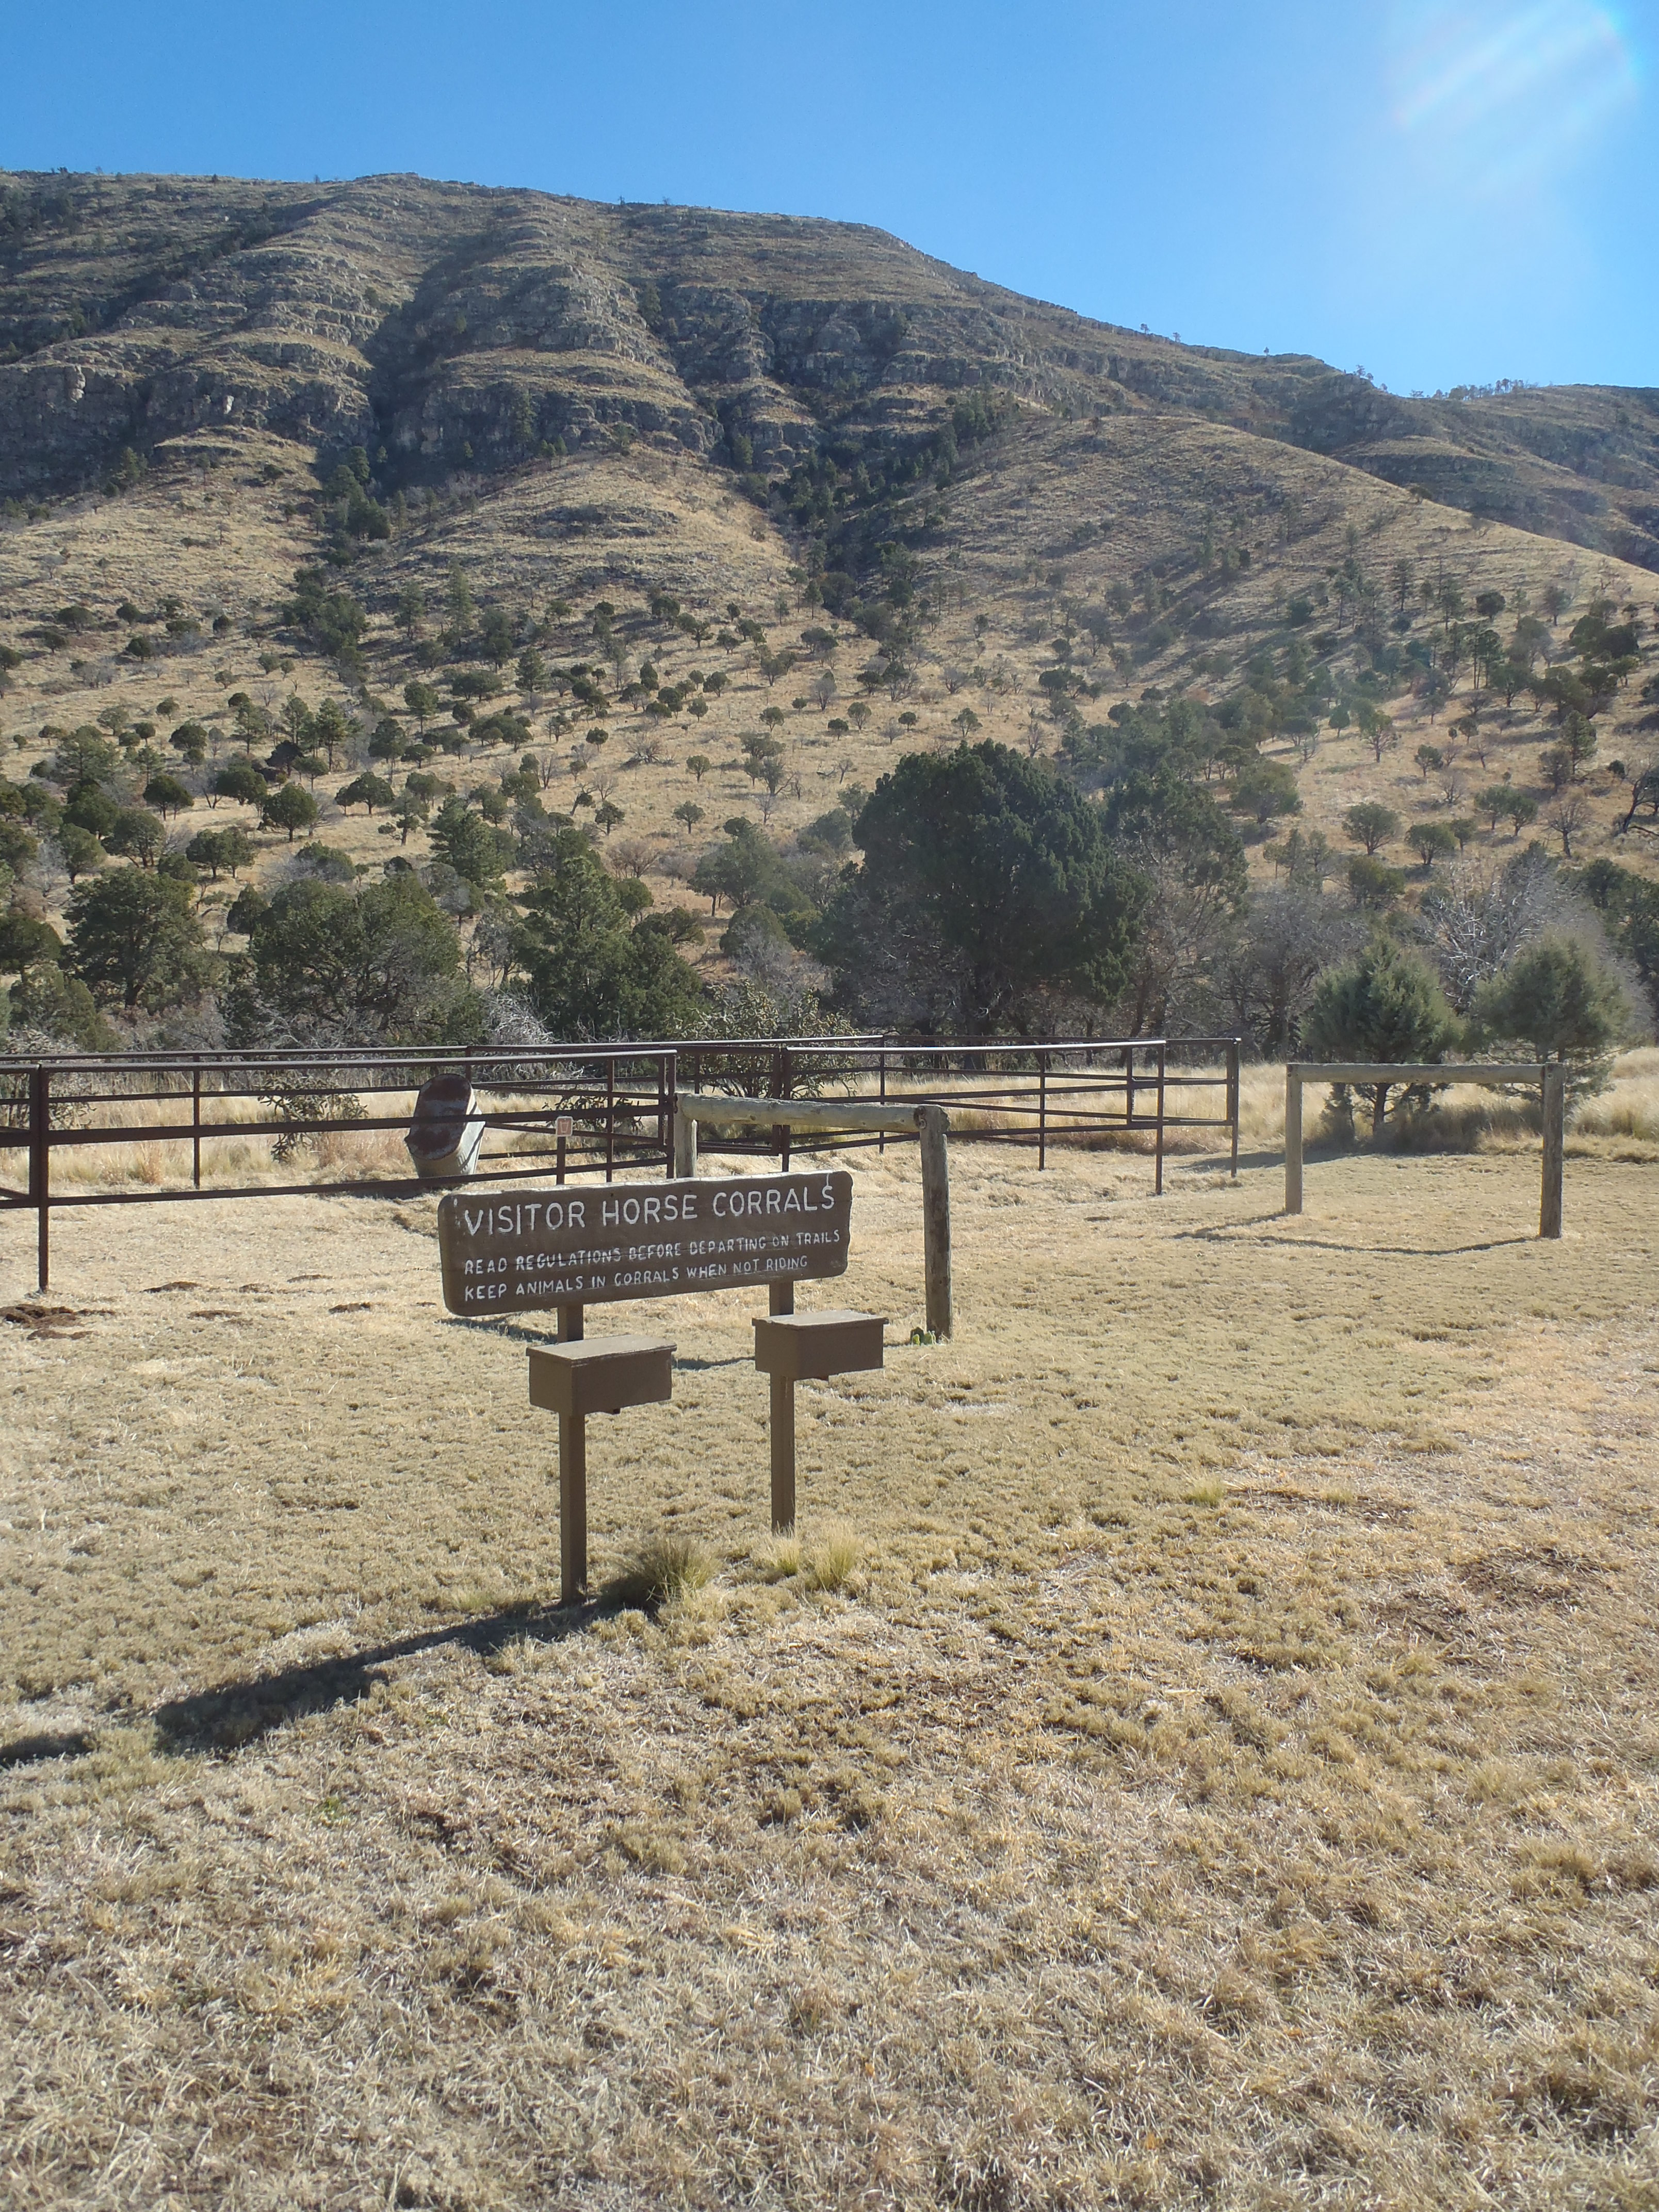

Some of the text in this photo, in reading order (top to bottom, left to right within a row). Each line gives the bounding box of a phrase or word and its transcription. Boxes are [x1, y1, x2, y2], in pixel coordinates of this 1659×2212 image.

[465, 1185, 835, 1236] VISITOR HORSE CORRALS
[465, 1230, 840, 1275] READ REGULATIONS BEFORE DEPARTING ON TRAILS
[465, 1256, 807, 1301] KEEP ANIMALS IN CORRALS WHEN NOT RIDING
